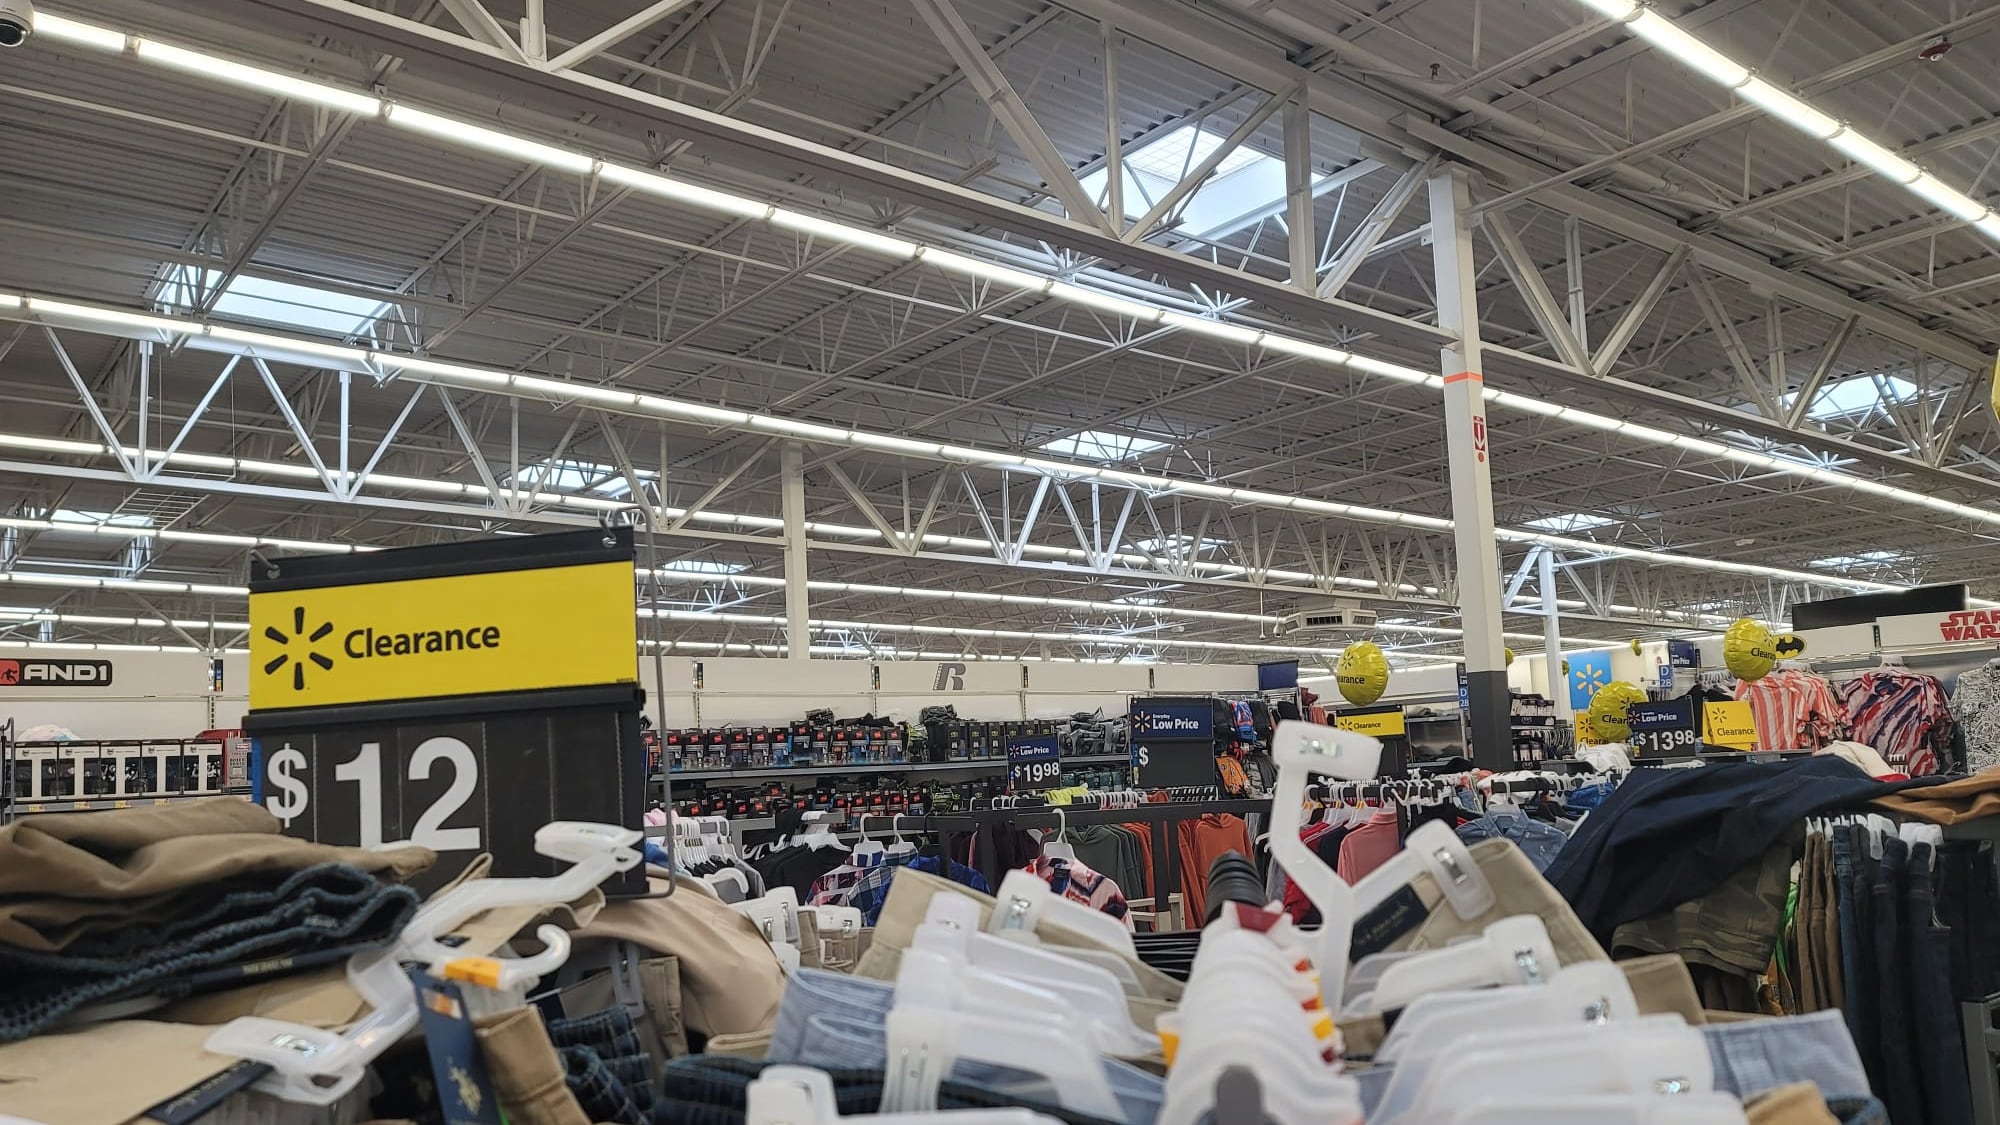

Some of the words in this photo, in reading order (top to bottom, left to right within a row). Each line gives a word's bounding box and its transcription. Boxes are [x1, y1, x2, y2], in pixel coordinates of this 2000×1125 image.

[1941, 624, 2000, 641] WAR
[345, 626, 500, 658] Clearance
[24, 664, 107, 681] AND1
[1661, 667, 1669, 676] D
[1661, 679, 1672, 687] 28
[1460, 688, 1467, 697] D
[1642, 715, 1657, 723] Low
[1658, 713, 1677, 722] Price
[1152, 719, 1173, 730] Low
[1174, 718, 1199, 730] Price
[1353, 722, 1381, 730] Clearance
[1717, 728, 1755, 737] Clearance
[1020, 748, 1033, 756] Low
[1033, 746, 1049, 755] Price
